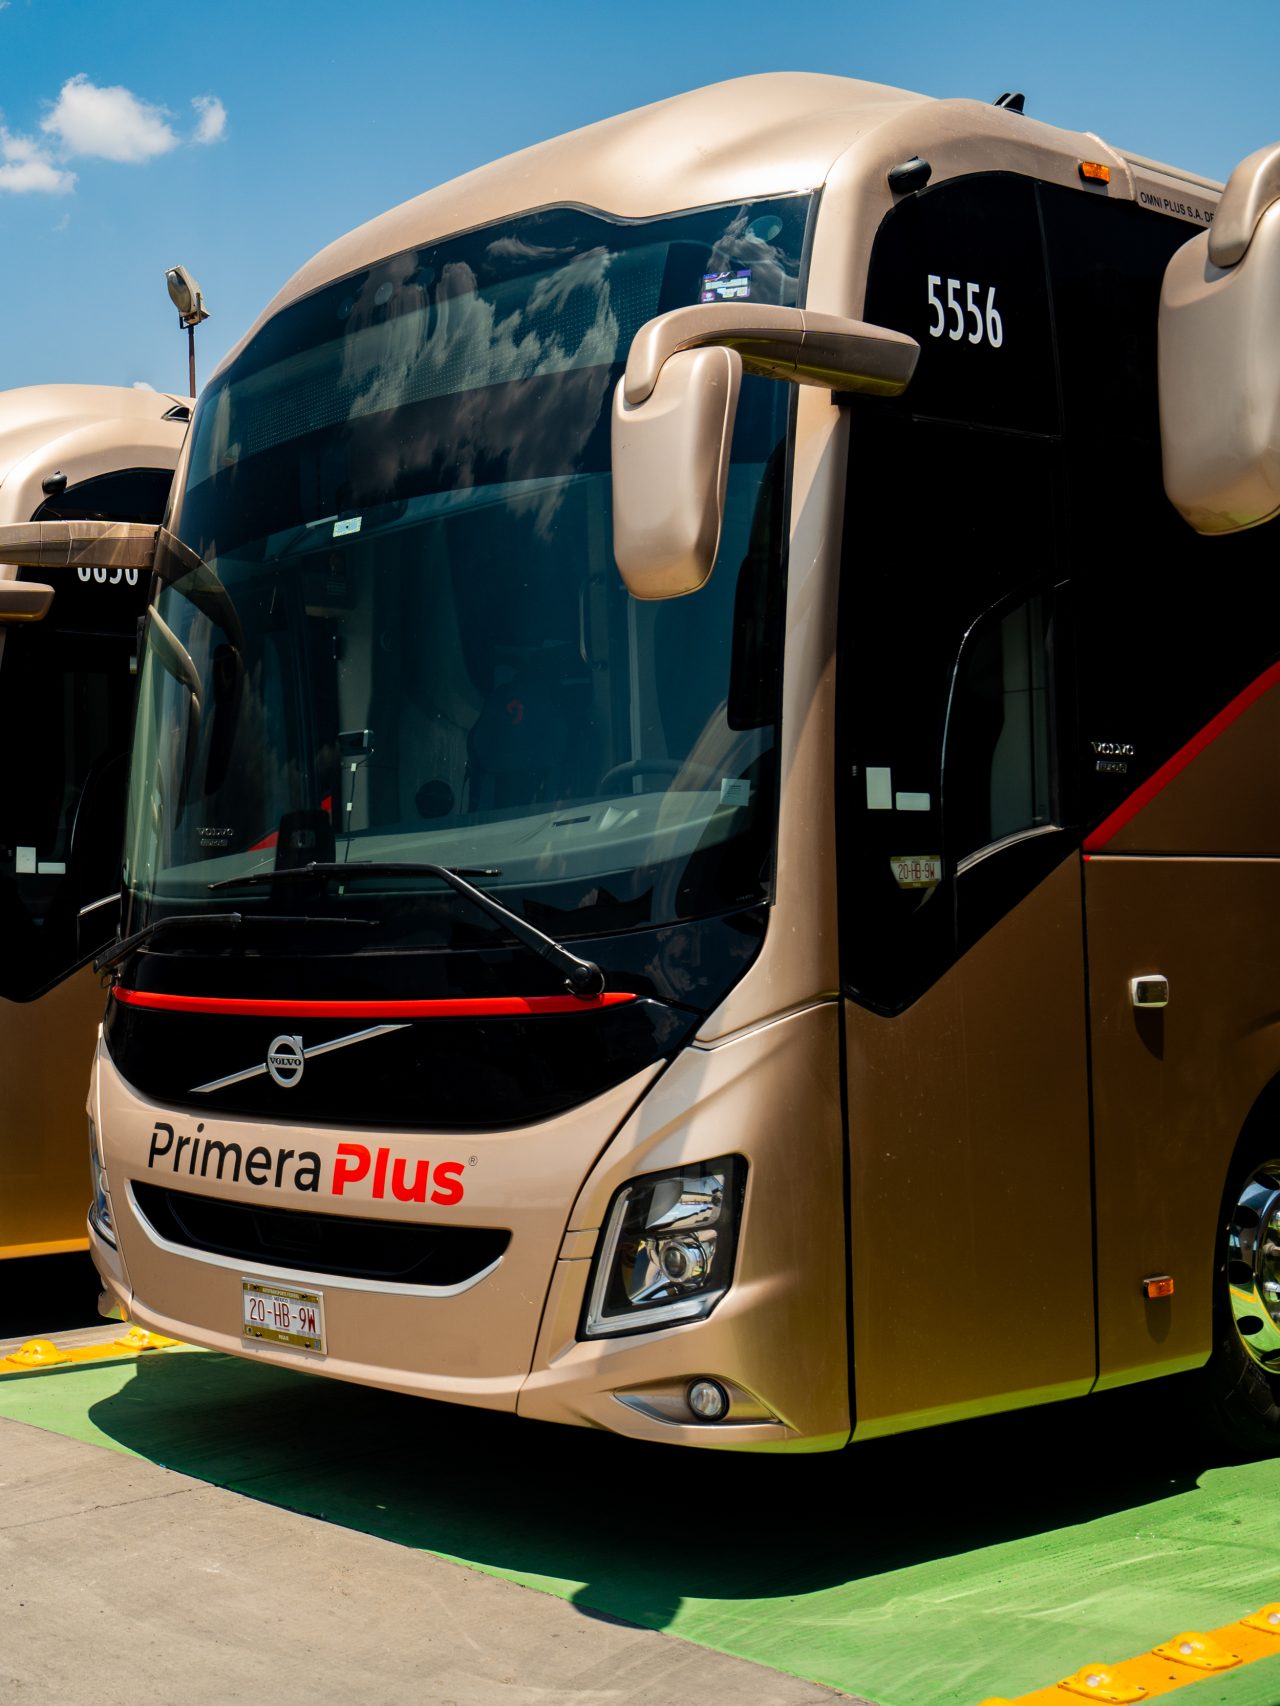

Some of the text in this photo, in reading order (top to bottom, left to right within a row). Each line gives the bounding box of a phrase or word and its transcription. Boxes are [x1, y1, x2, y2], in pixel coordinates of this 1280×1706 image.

[1141, 192, 1162, 208] OMNI
[1163, 199, 1185, 215] PLUS
[927, 274, 1003, 348] 5556
[1090, 741, 1134, 756] VOLVO
[270, 1057, 301, 1066] VOLVO
[148, 1121, 466, 1206] Primera Plus
[250, 1298, 316, 1333] 20-HB-9W
